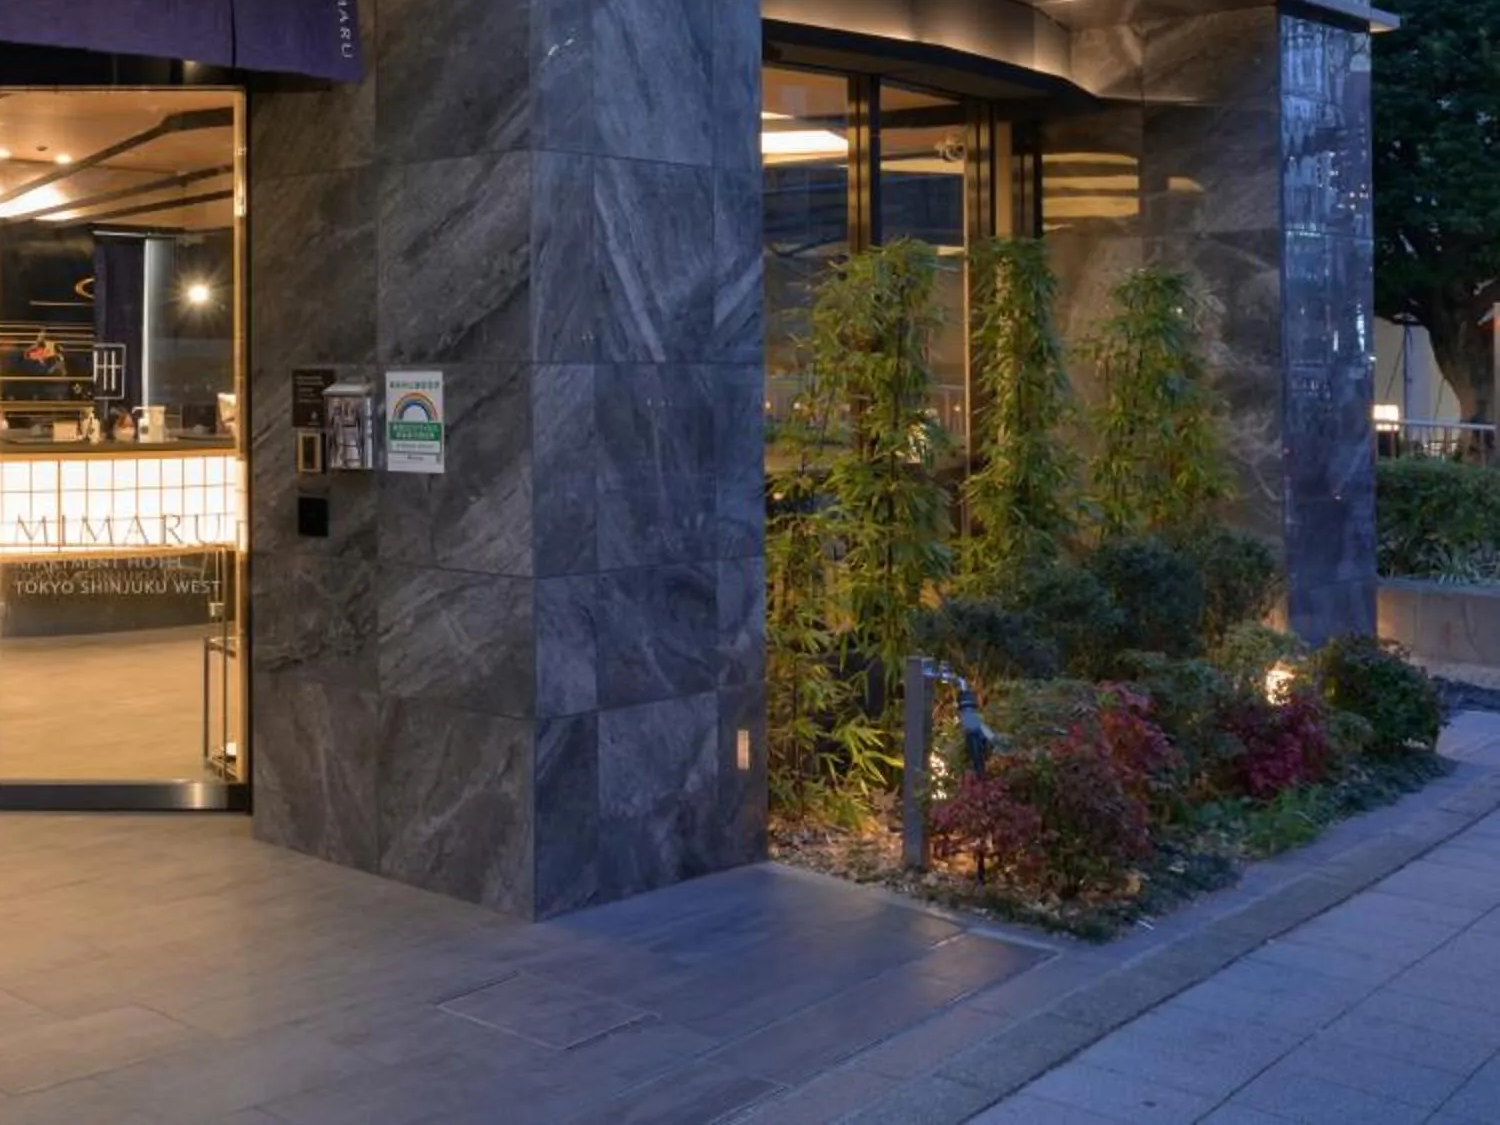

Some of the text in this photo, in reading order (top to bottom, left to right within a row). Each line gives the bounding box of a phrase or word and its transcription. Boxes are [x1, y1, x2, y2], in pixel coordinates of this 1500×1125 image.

[15, 513, 223, 546] MIMARU
[15, 579, 221, 595] TOKYO SHINJUKU WEST
